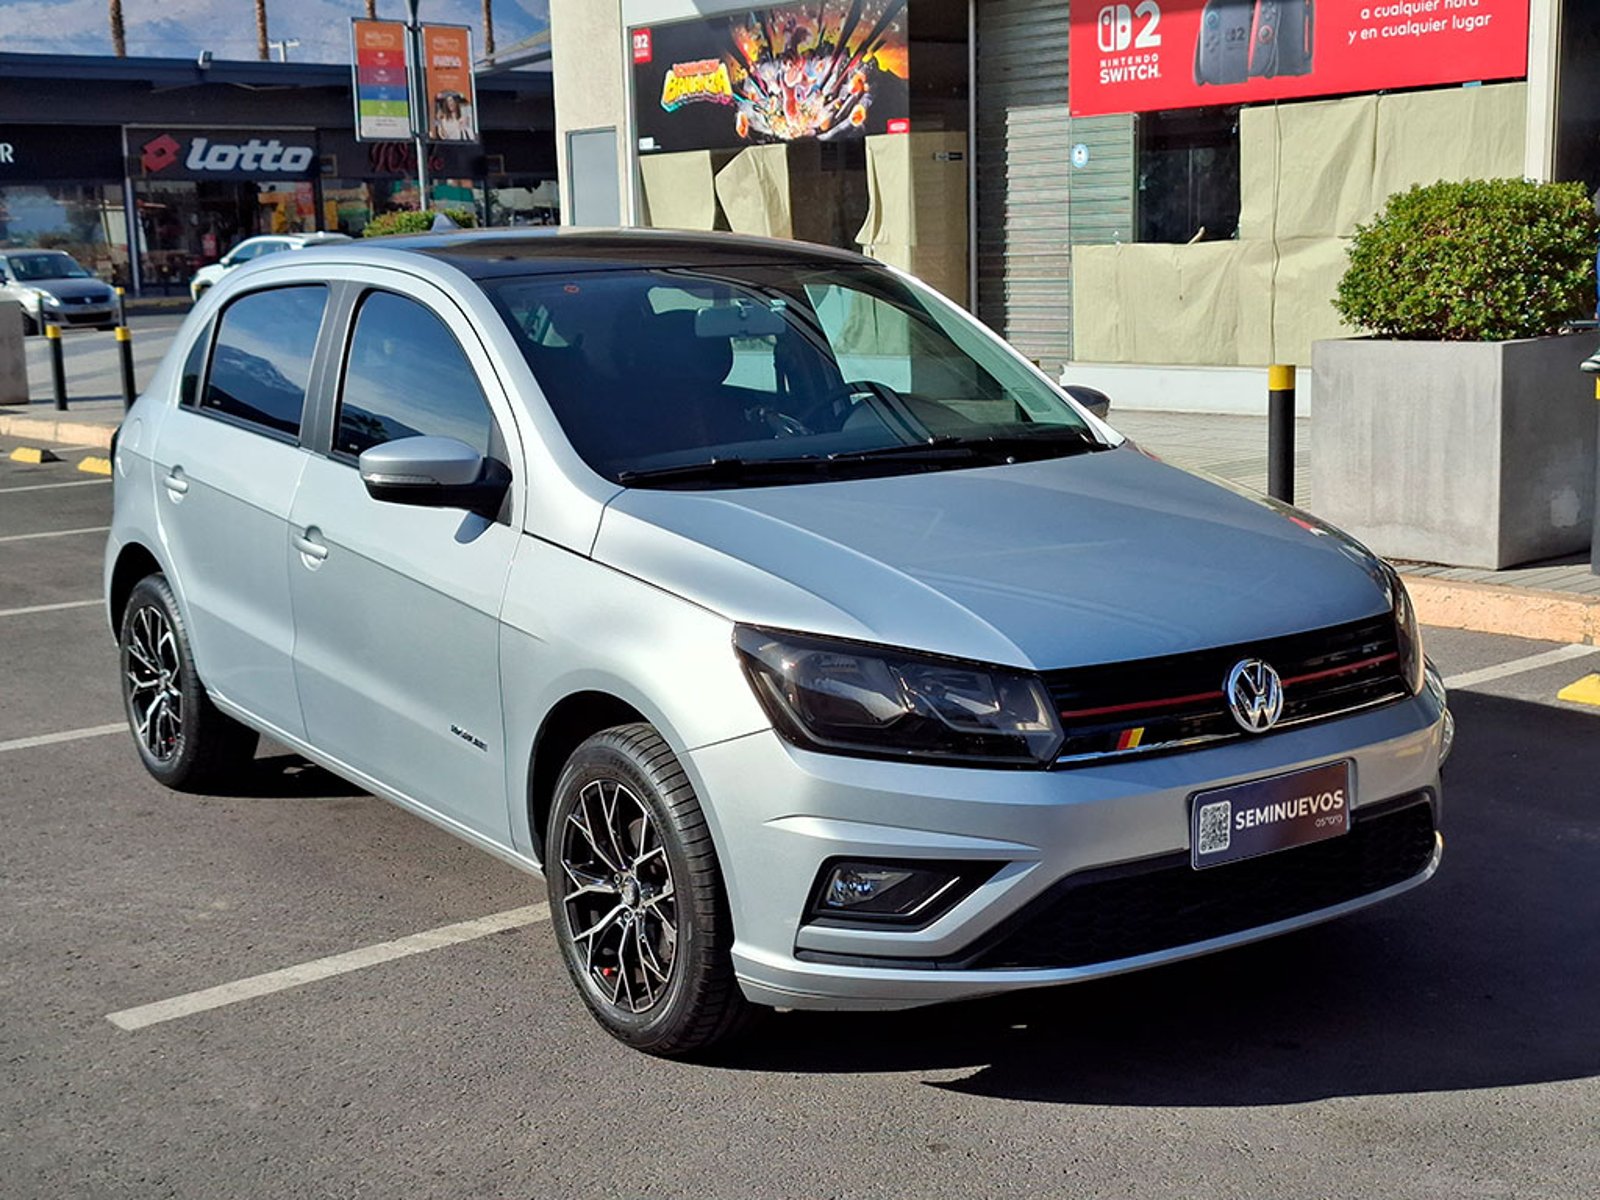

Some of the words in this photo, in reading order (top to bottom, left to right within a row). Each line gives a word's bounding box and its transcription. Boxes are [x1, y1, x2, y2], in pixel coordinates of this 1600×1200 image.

[1360, 8, 1371, 20] a
[1373, 0, 1439, 18] cualquier
[1347, 30, 1357, 45] y
[1360, 27, 1378, 40] en
[1380, 18, 1448, 37] cualquier
[1452, 14, 1493, 32] lugar
[1100, 52, 1159, 67] NINTENDO
[1099, 64, 1160, 84] SWITCH
[185, 137, 314, 172] lotto
[1234, 788, 1345, 831] SEMINUEVOS
